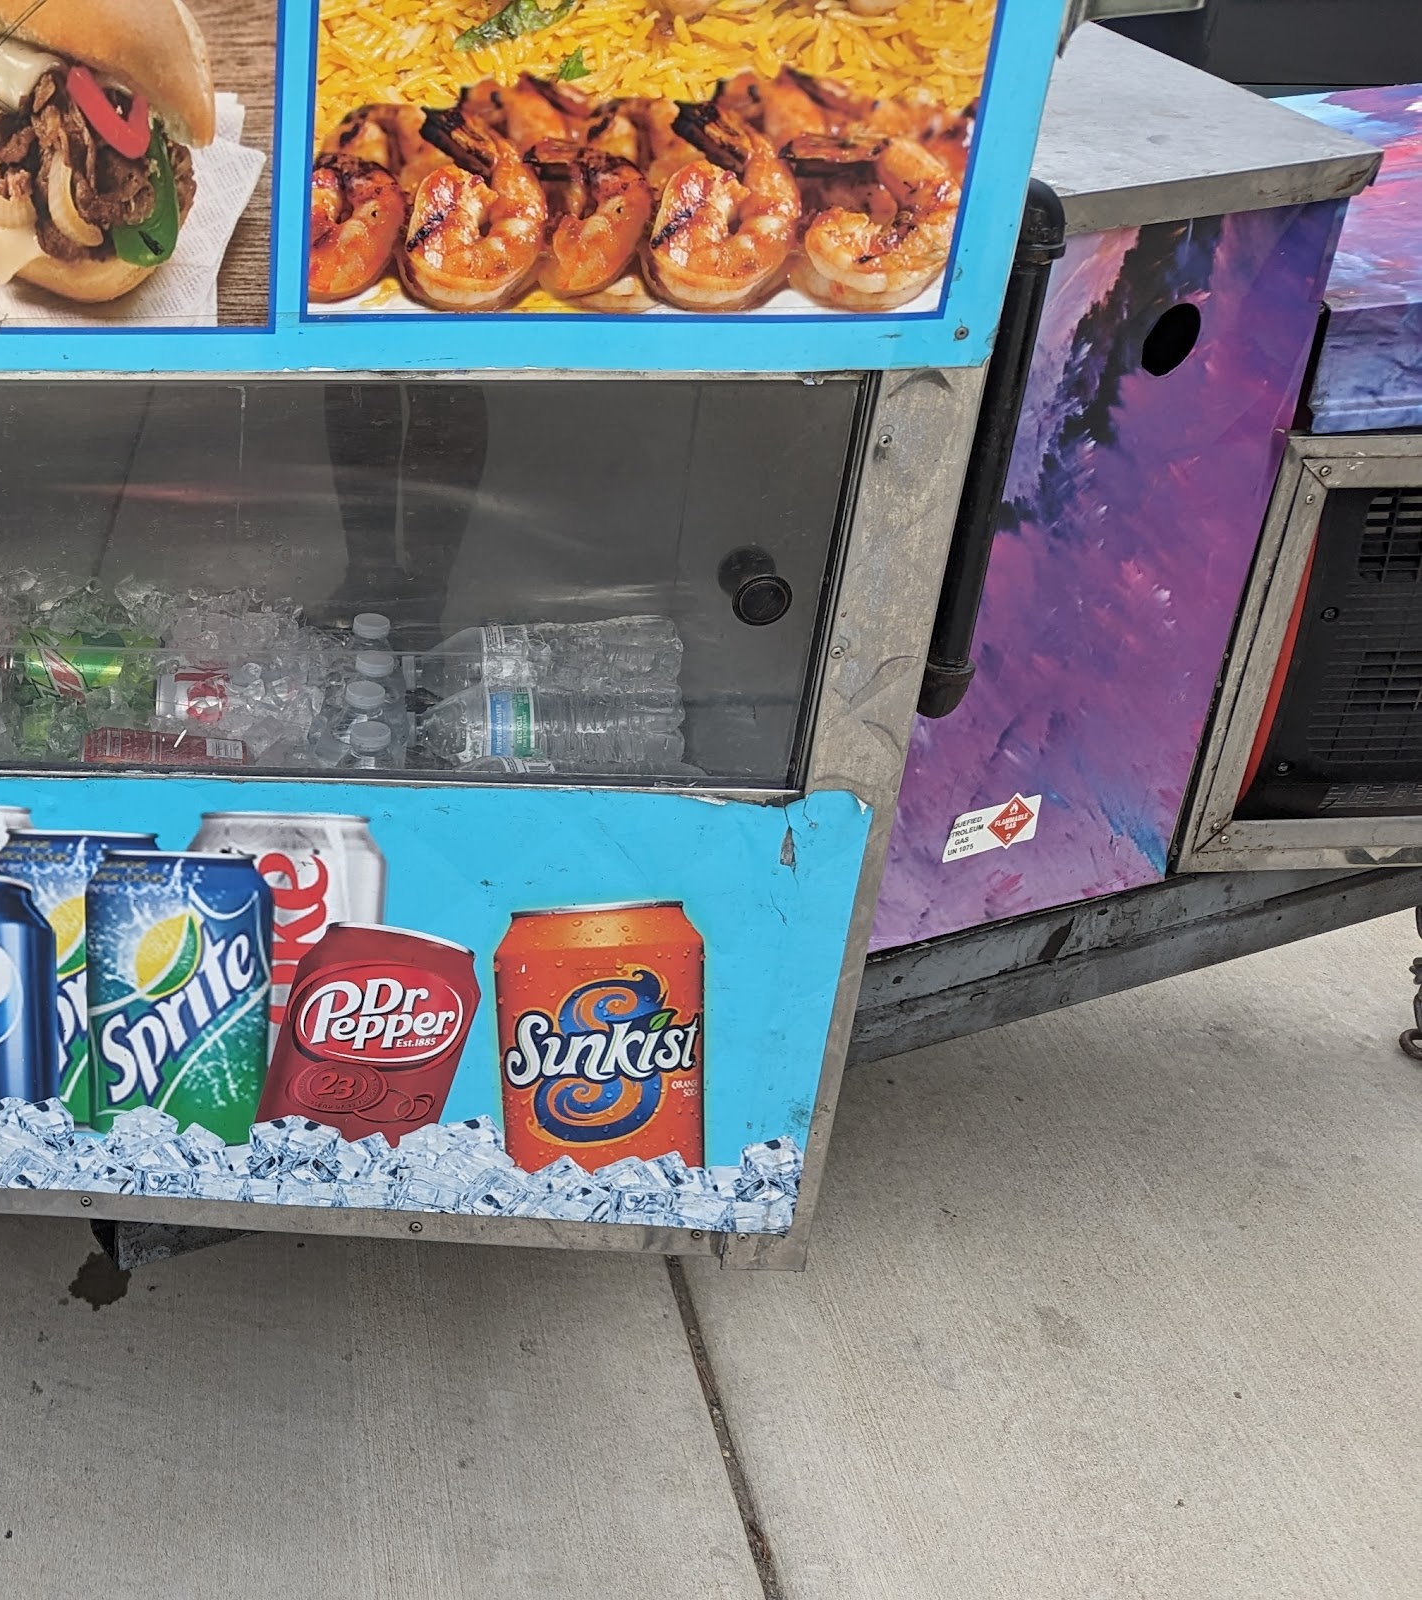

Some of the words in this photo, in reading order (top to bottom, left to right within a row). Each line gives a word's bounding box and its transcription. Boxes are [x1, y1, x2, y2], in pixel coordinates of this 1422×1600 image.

[495, 703, 503, 723] WATER
[953, 816, 983, 830] QUEFIED
[994, 812, 1029, 828] FLAMMABLE
[1004, 821, 1017, 831] GAS
[950, 824, 984, 839] TROLEUM
[947, 847, 958, 856] UN
[959, 843, 974, 853] 1075
[954, 836, 969, 846] GAS
[362, 977, 429, 1015] Dr
[100, 930, 257, 1104] Sprite
[300, 980, 456, 1050] Pepper
[506, 1012, 697, 1087] Sunkist
[317, 1070, 356, 1101] 23
